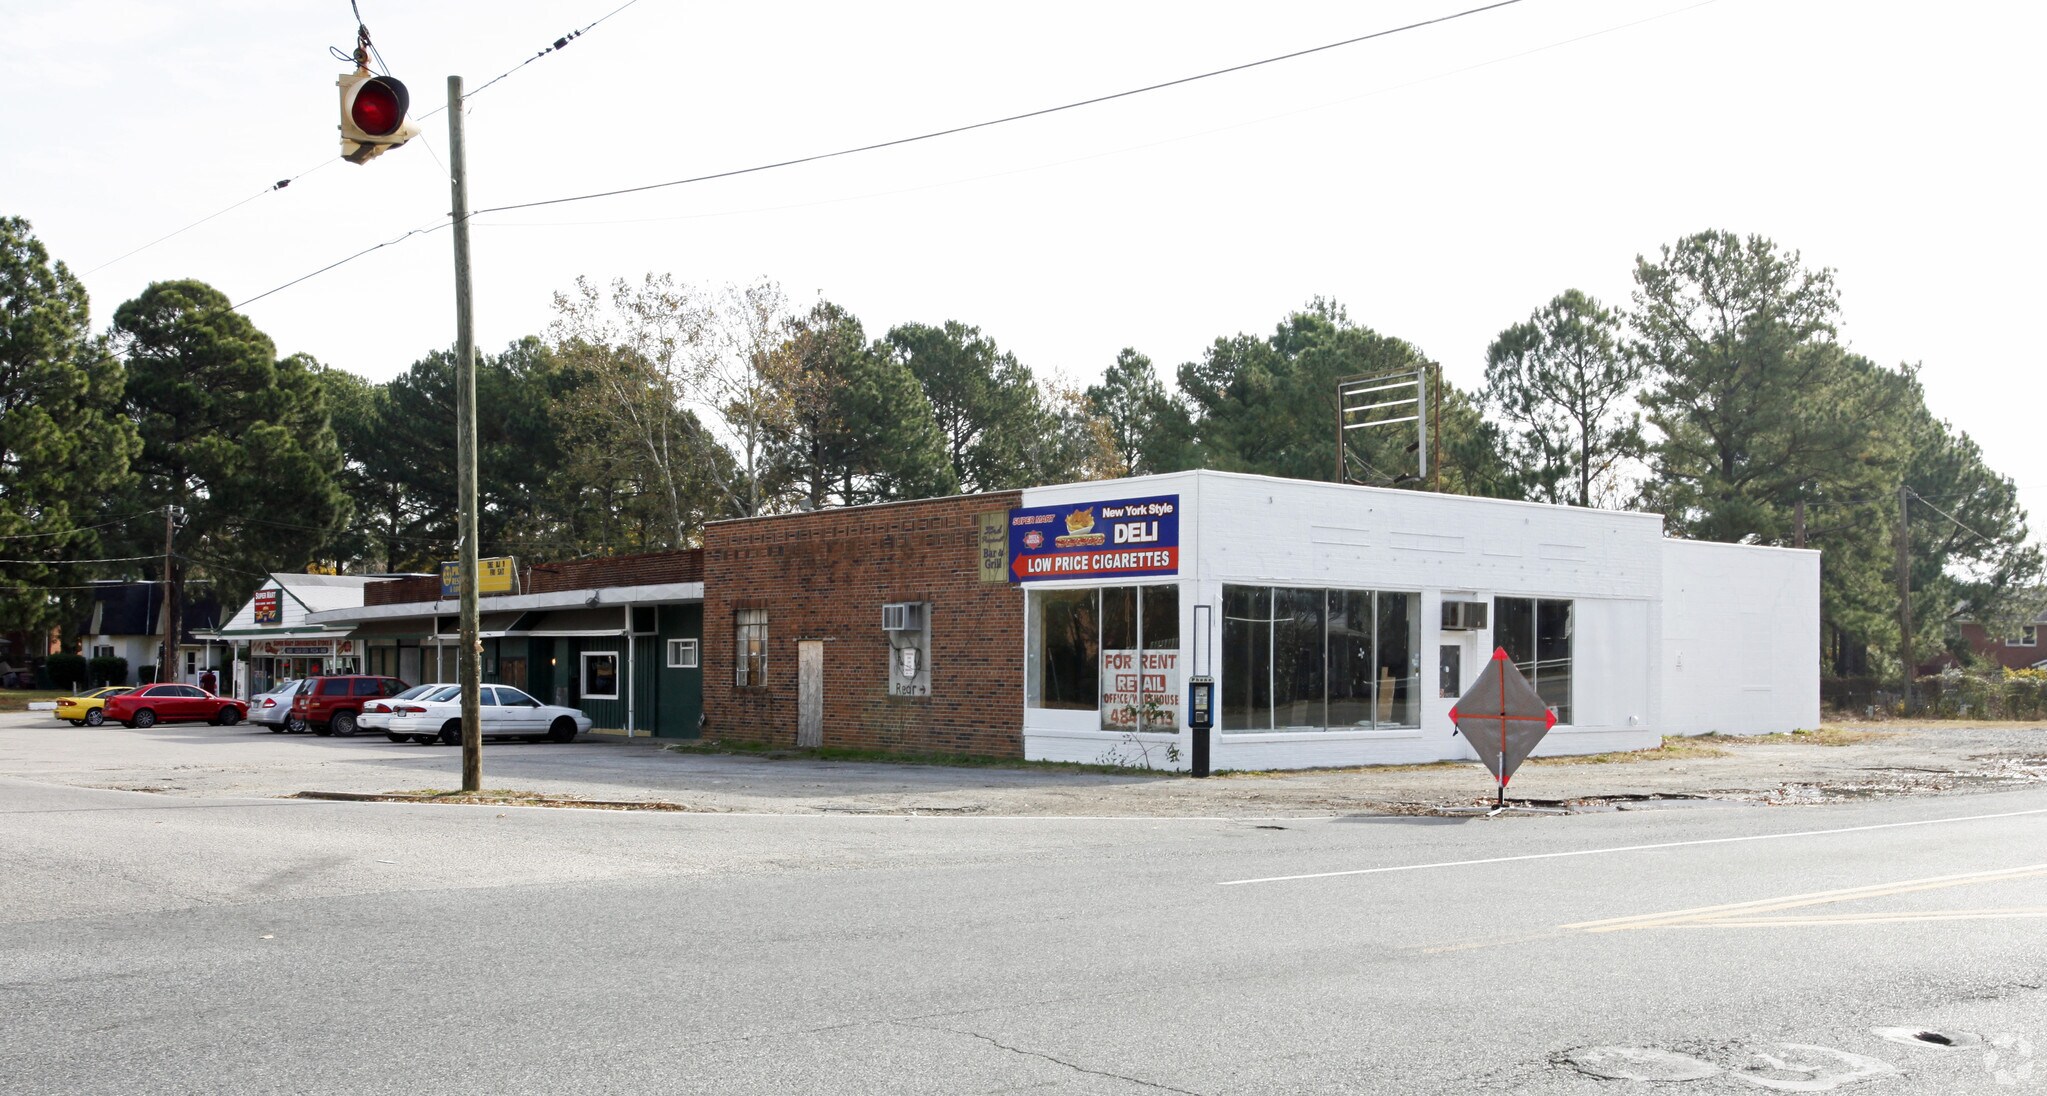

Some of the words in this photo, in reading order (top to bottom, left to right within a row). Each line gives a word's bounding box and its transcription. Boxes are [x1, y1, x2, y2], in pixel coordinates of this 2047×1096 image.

[1102, 507, 1124, 519] New
[1125, 505, 1148, 516] York
[1148, 502, 1174, 517] Style
[1012, 516, 1035, 526] SUPER
[1113, 520, 1158, 544] DELI
[983, 548, 996, 558] Bar
[984, 559, 1002, 569] Grill
[1028, 557, 1052, 573] LOW
[1055, 555, 1089, 571] PRICE
[1092, 550, 1170, 570] CIGARETTES
[1105, 653, 1132, 670] FOR
[1141, 654, 1178, 670] RENT
[896, 682, 917, 695] Rear
[1116, 676, 1165, 692] REAIL
